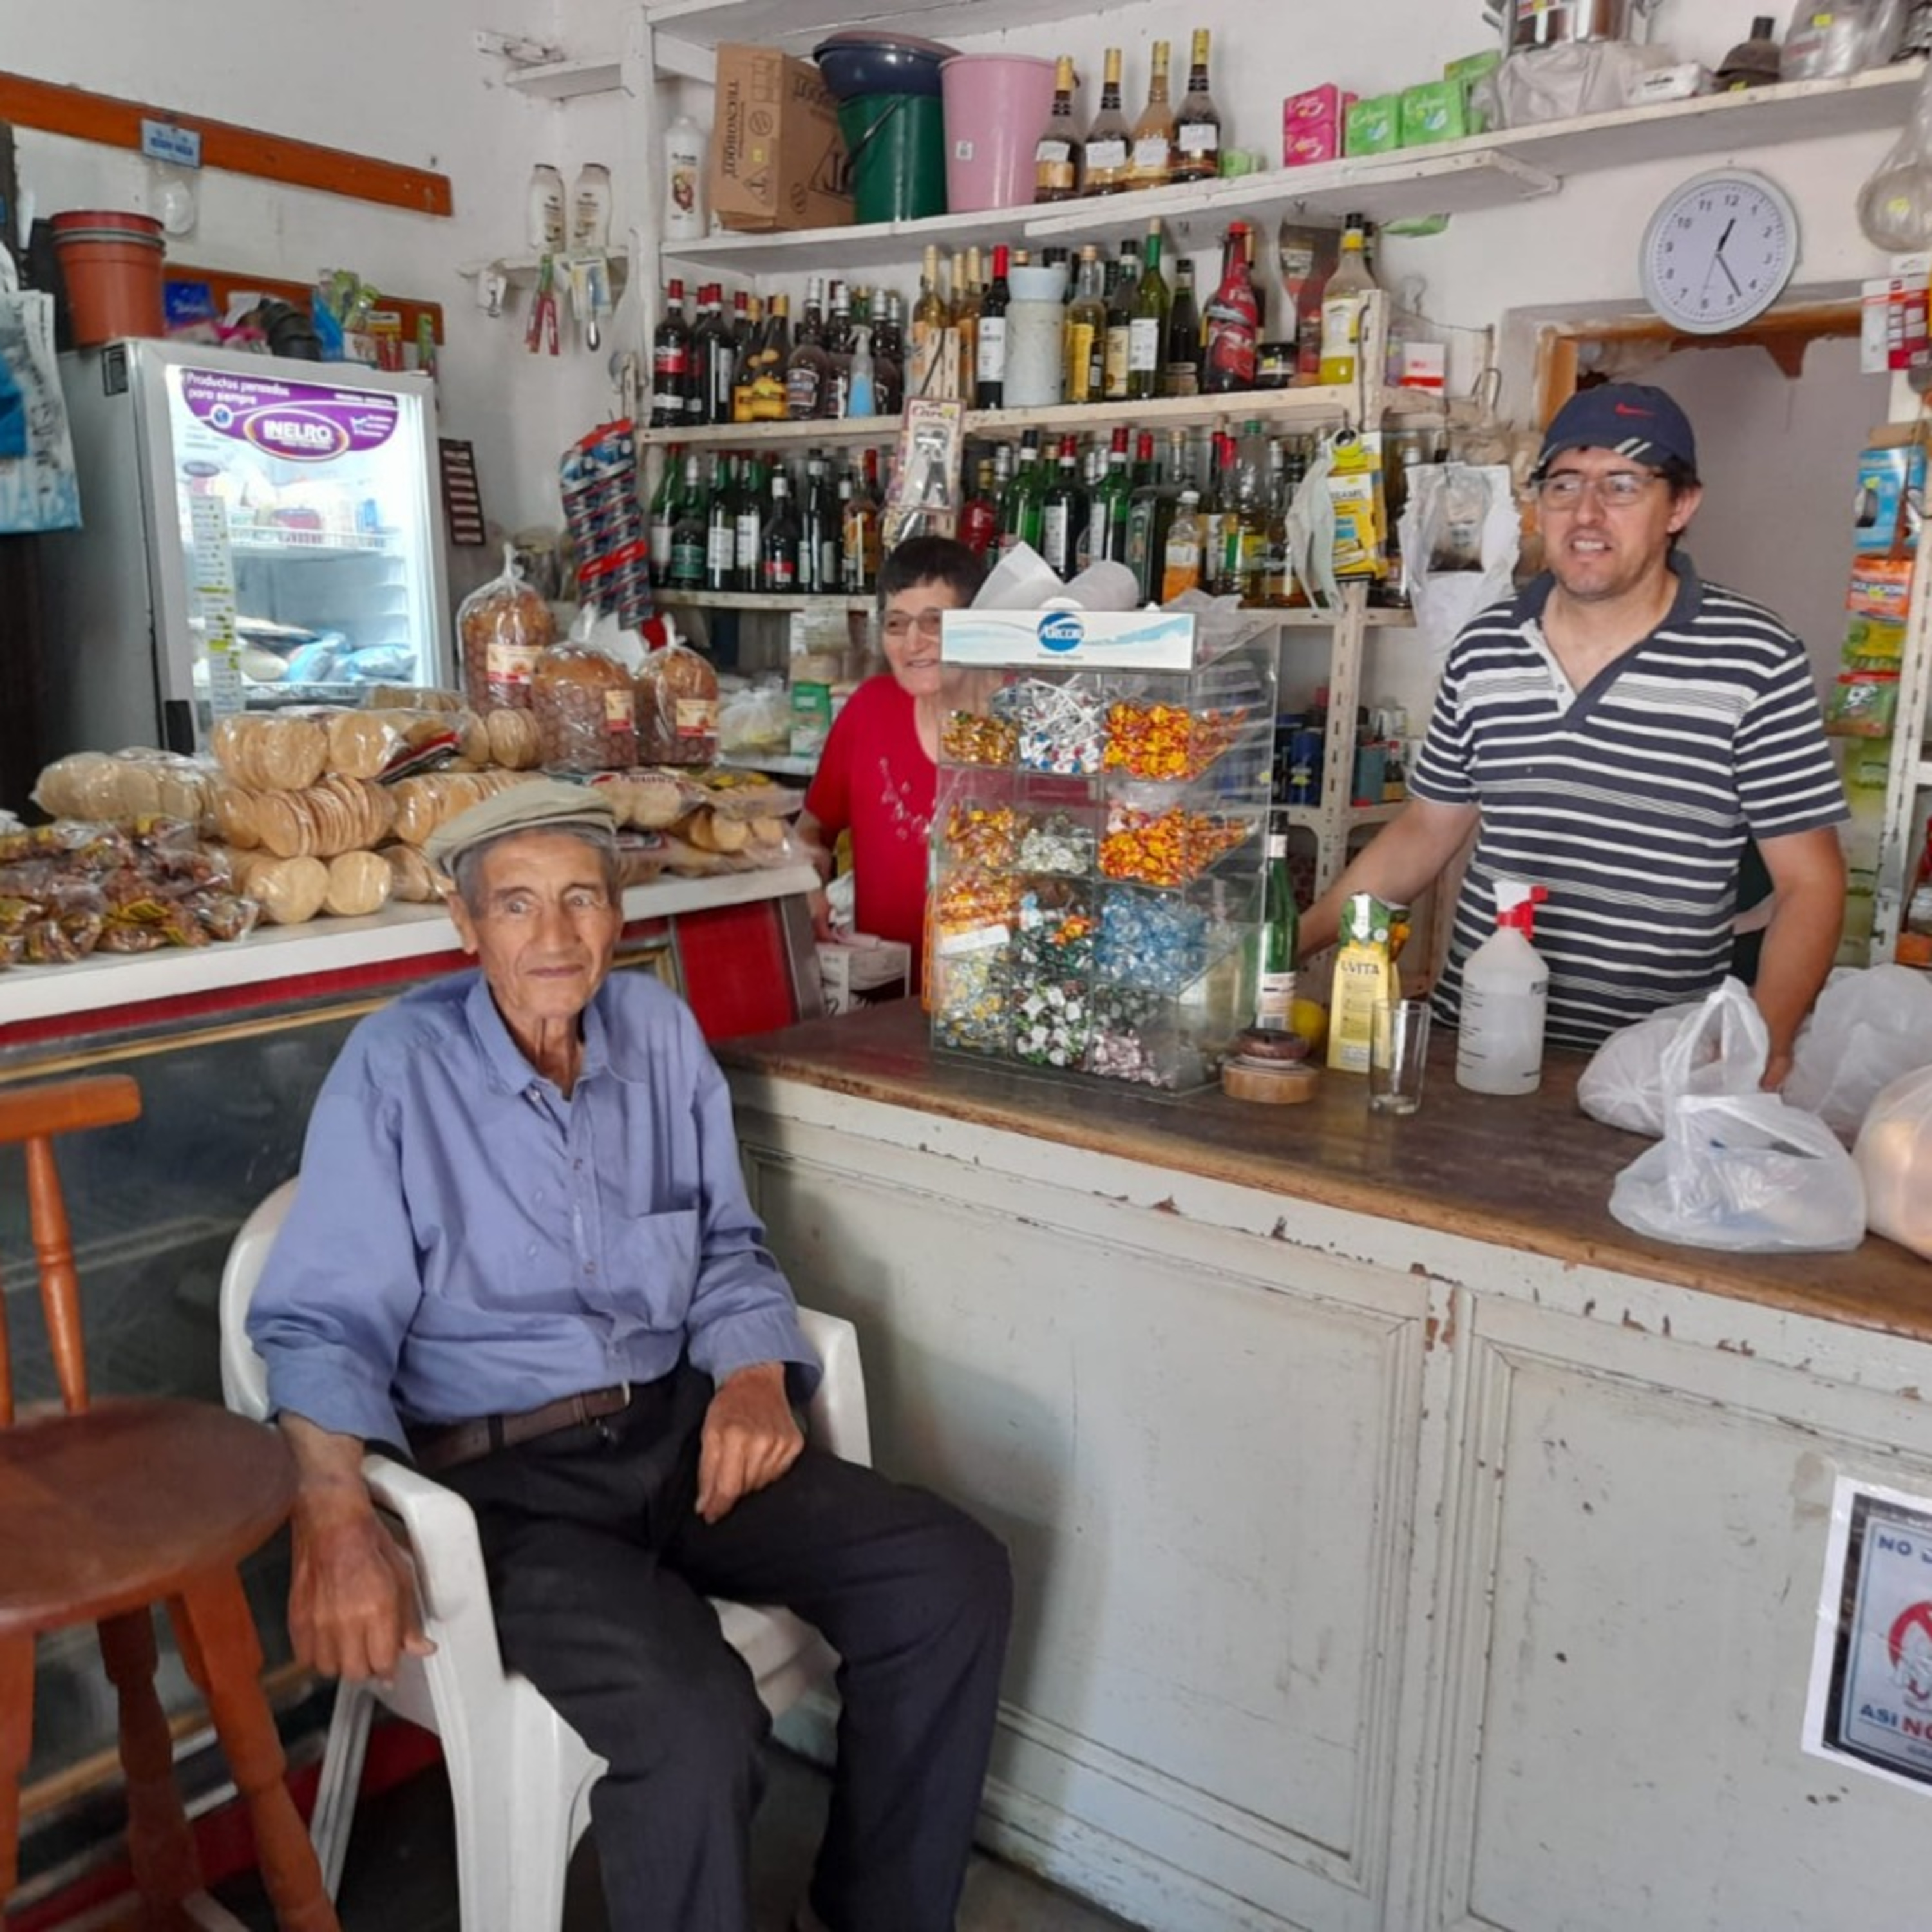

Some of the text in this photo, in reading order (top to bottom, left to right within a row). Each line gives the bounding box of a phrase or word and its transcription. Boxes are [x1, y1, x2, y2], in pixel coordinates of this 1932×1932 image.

[1699, 199, 1712, 211] 11
[1724, 194, 1739, 207] 12
[1751, 204, 1758, 216] 1
[1678, 216, 1692, 229] 10
[1763, 226, 1772, 238] 2
[1665, 241, 1674, 253] 9
[1763, 253, 1772, 265] 3
[1666, 267, 1674, 280] 8
[1748, 279, 1757, 290] 4
[1680, 288, 1689, 299] 7
[1700, 298, 1709, 310] 6
[1727, 294, 1735, 306] 5
[187, 372, 238, 390] Productos
[189, 388, 214, 400] para
[263, 419, 333, 442] INELRO
[1879, 1535, 1913, 1557] NO
[1860, 1703, 1898, 1727] ASI
